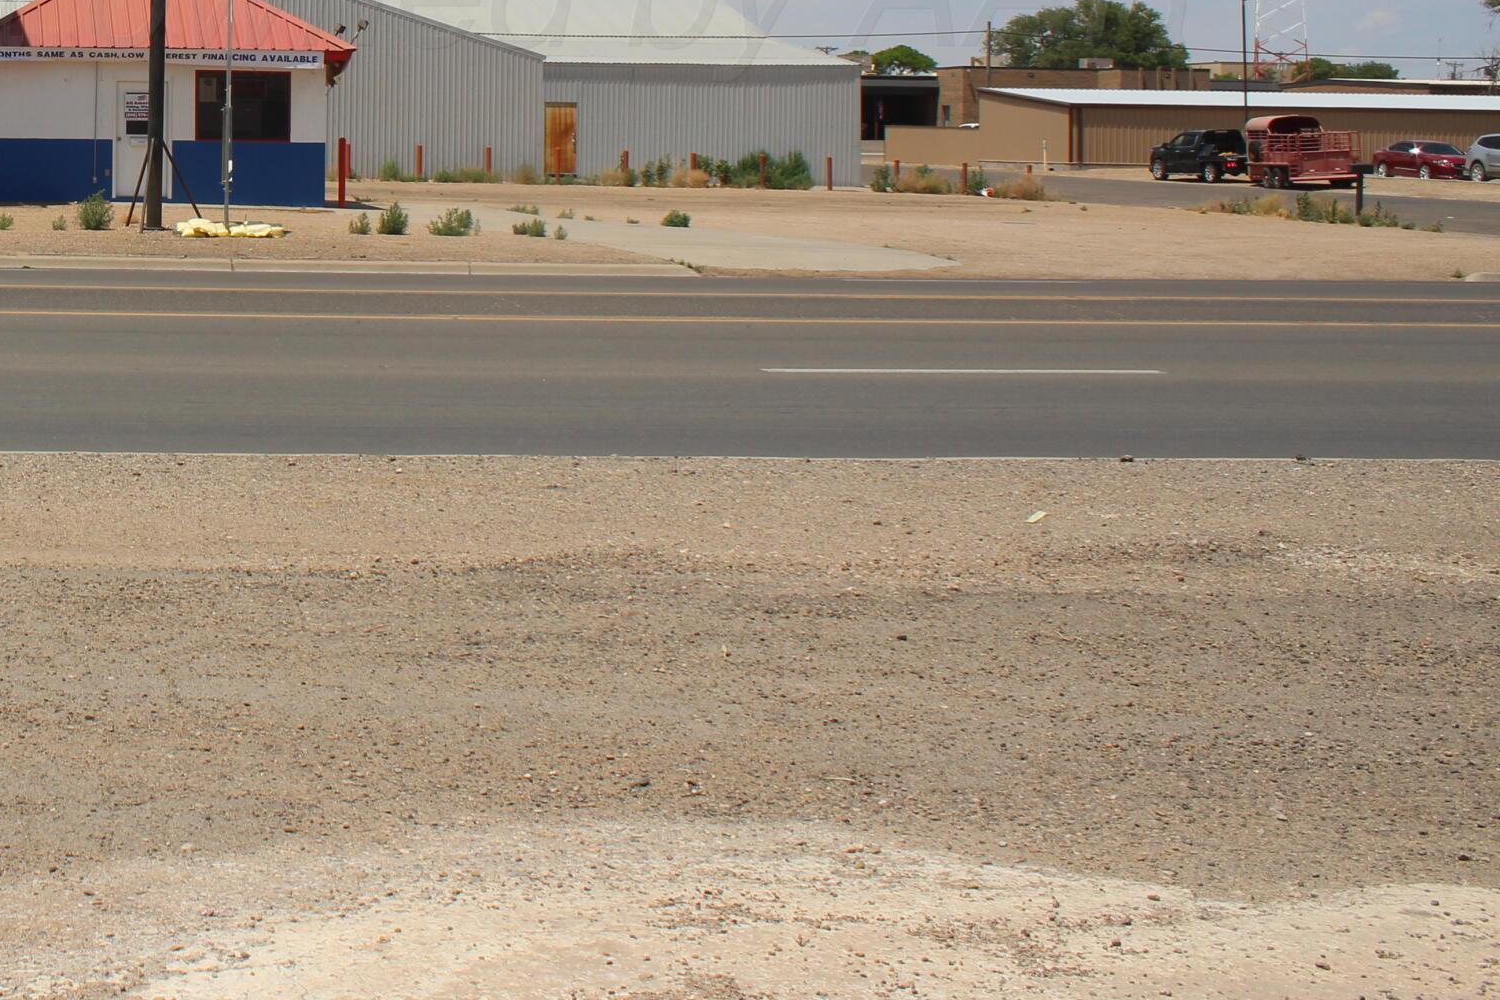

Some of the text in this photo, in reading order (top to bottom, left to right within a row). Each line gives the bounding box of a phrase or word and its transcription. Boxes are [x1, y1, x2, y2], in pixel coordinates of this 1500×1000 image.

[36, 50, 65, 58] SAME
[121, 51, 145, 59] LOW
[165, 52, 198, 60] EREST
[261, 55, 319, 64] AVAILABLE
